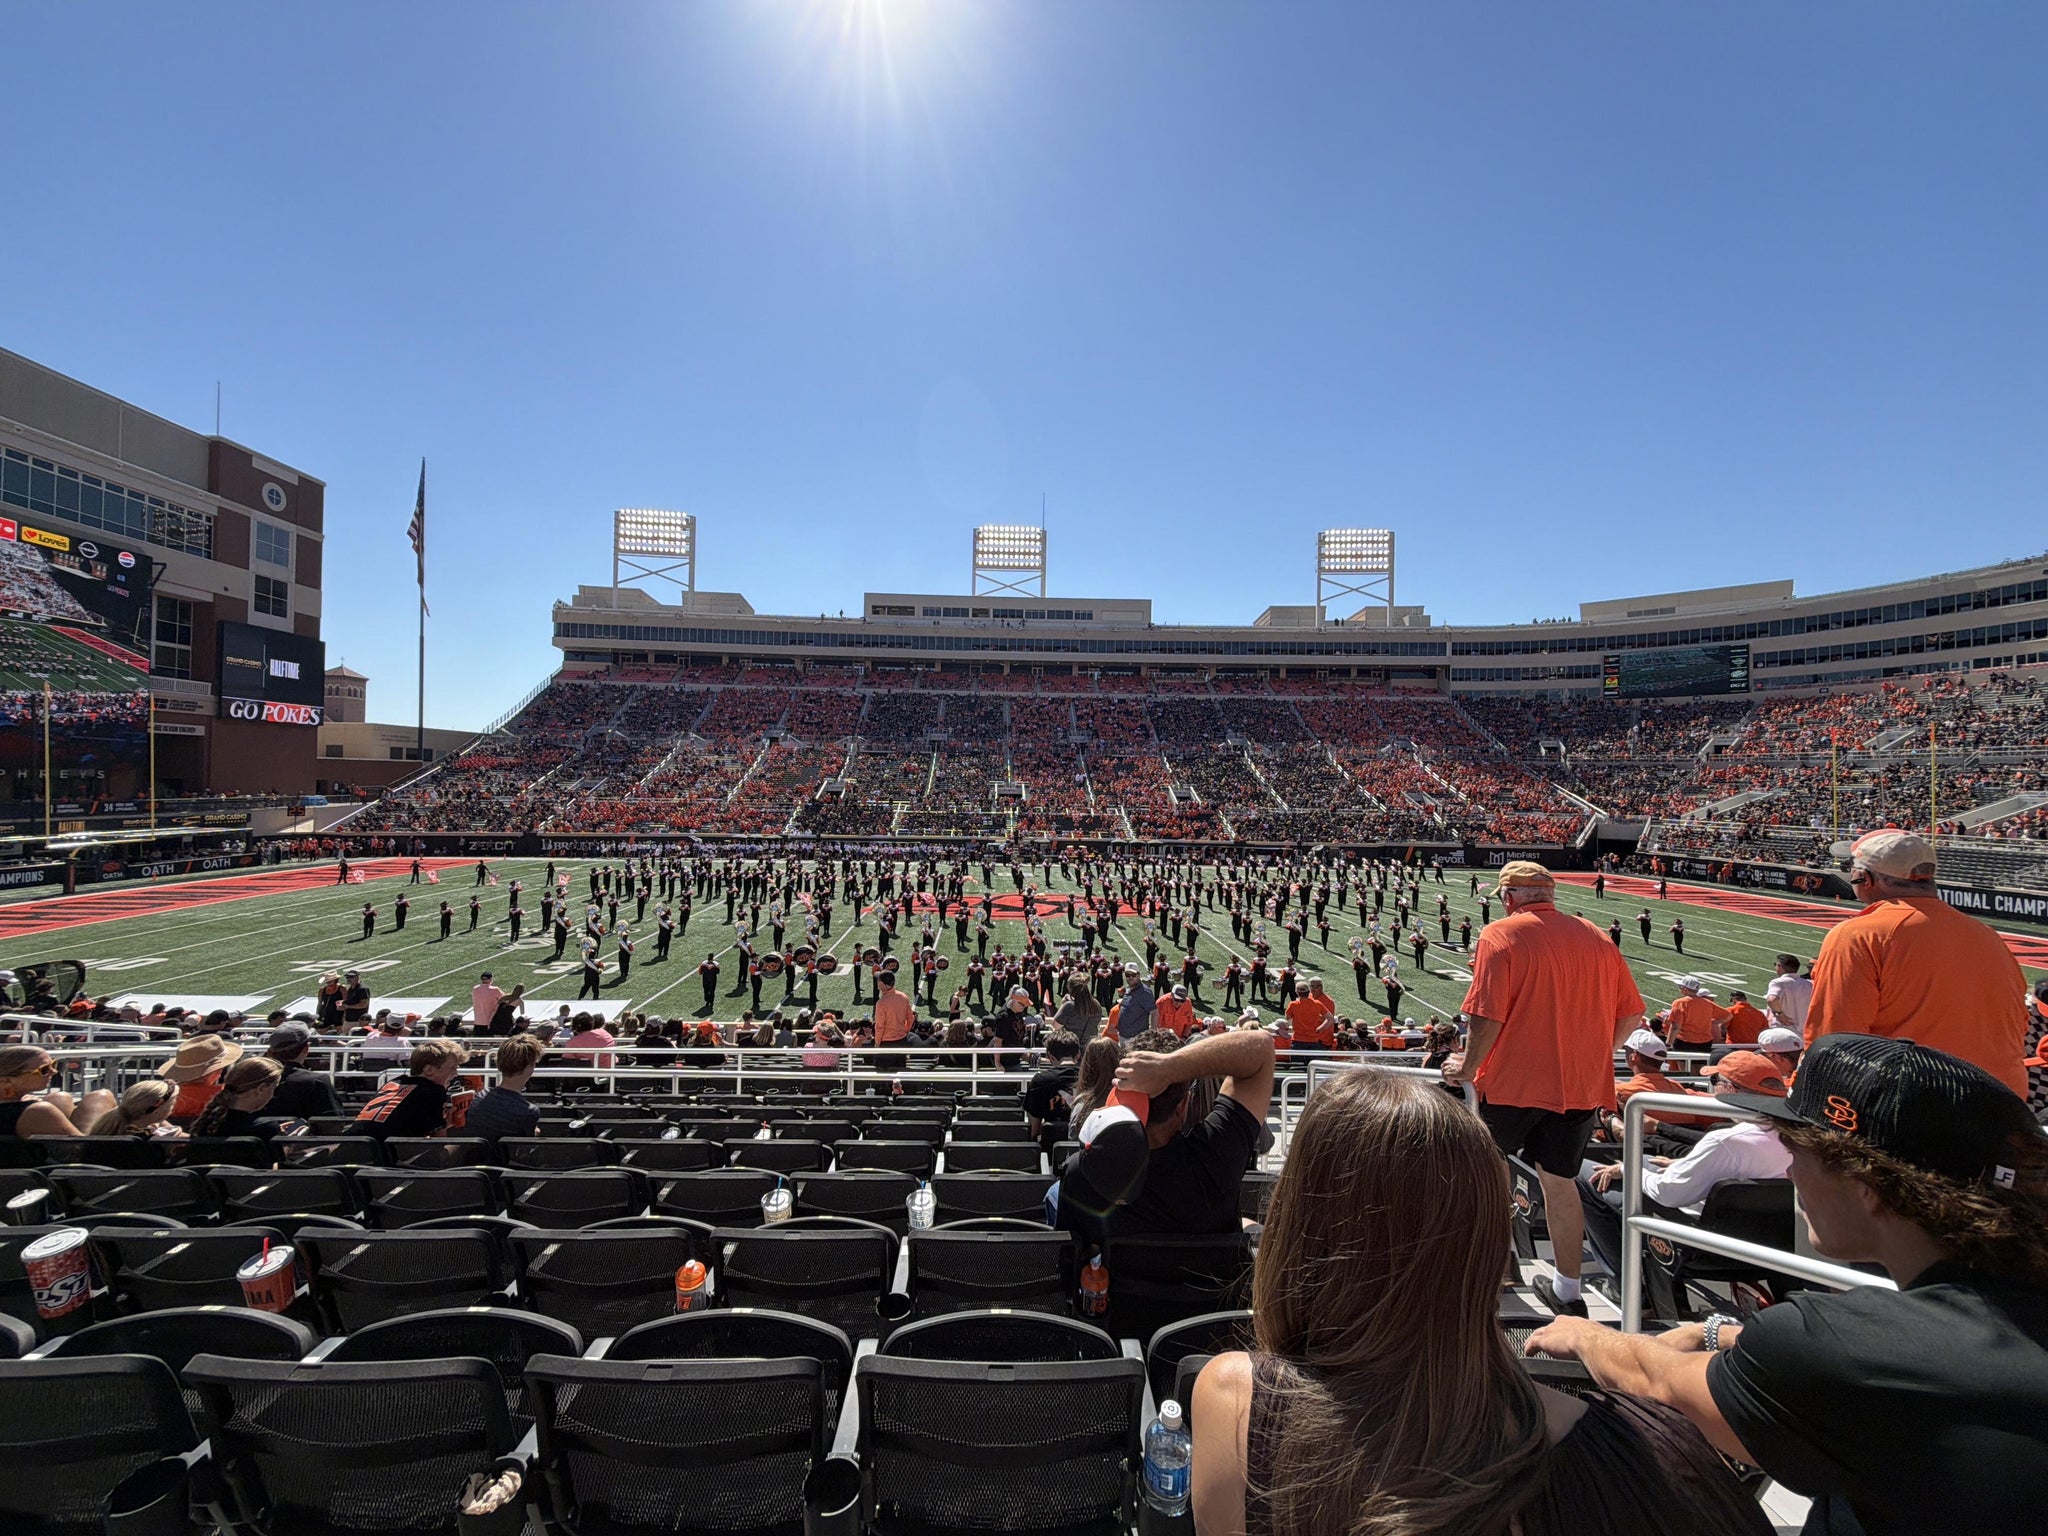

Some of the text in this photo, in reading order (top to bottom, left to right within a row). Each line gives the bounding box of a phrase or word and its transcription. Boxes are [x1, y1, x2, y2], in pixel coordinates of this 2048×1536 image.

[269, 658, 300, 680] HALFTIME
[229, 700, 321, 726] GO POKES
[202, 858, 231, 869] OATH
[1430, 853, 1465, 865] devon
[102, 872, 123, 880] OATH
[141, 864, 175, 877] OATH
[288, 960, 402, 972] 20
